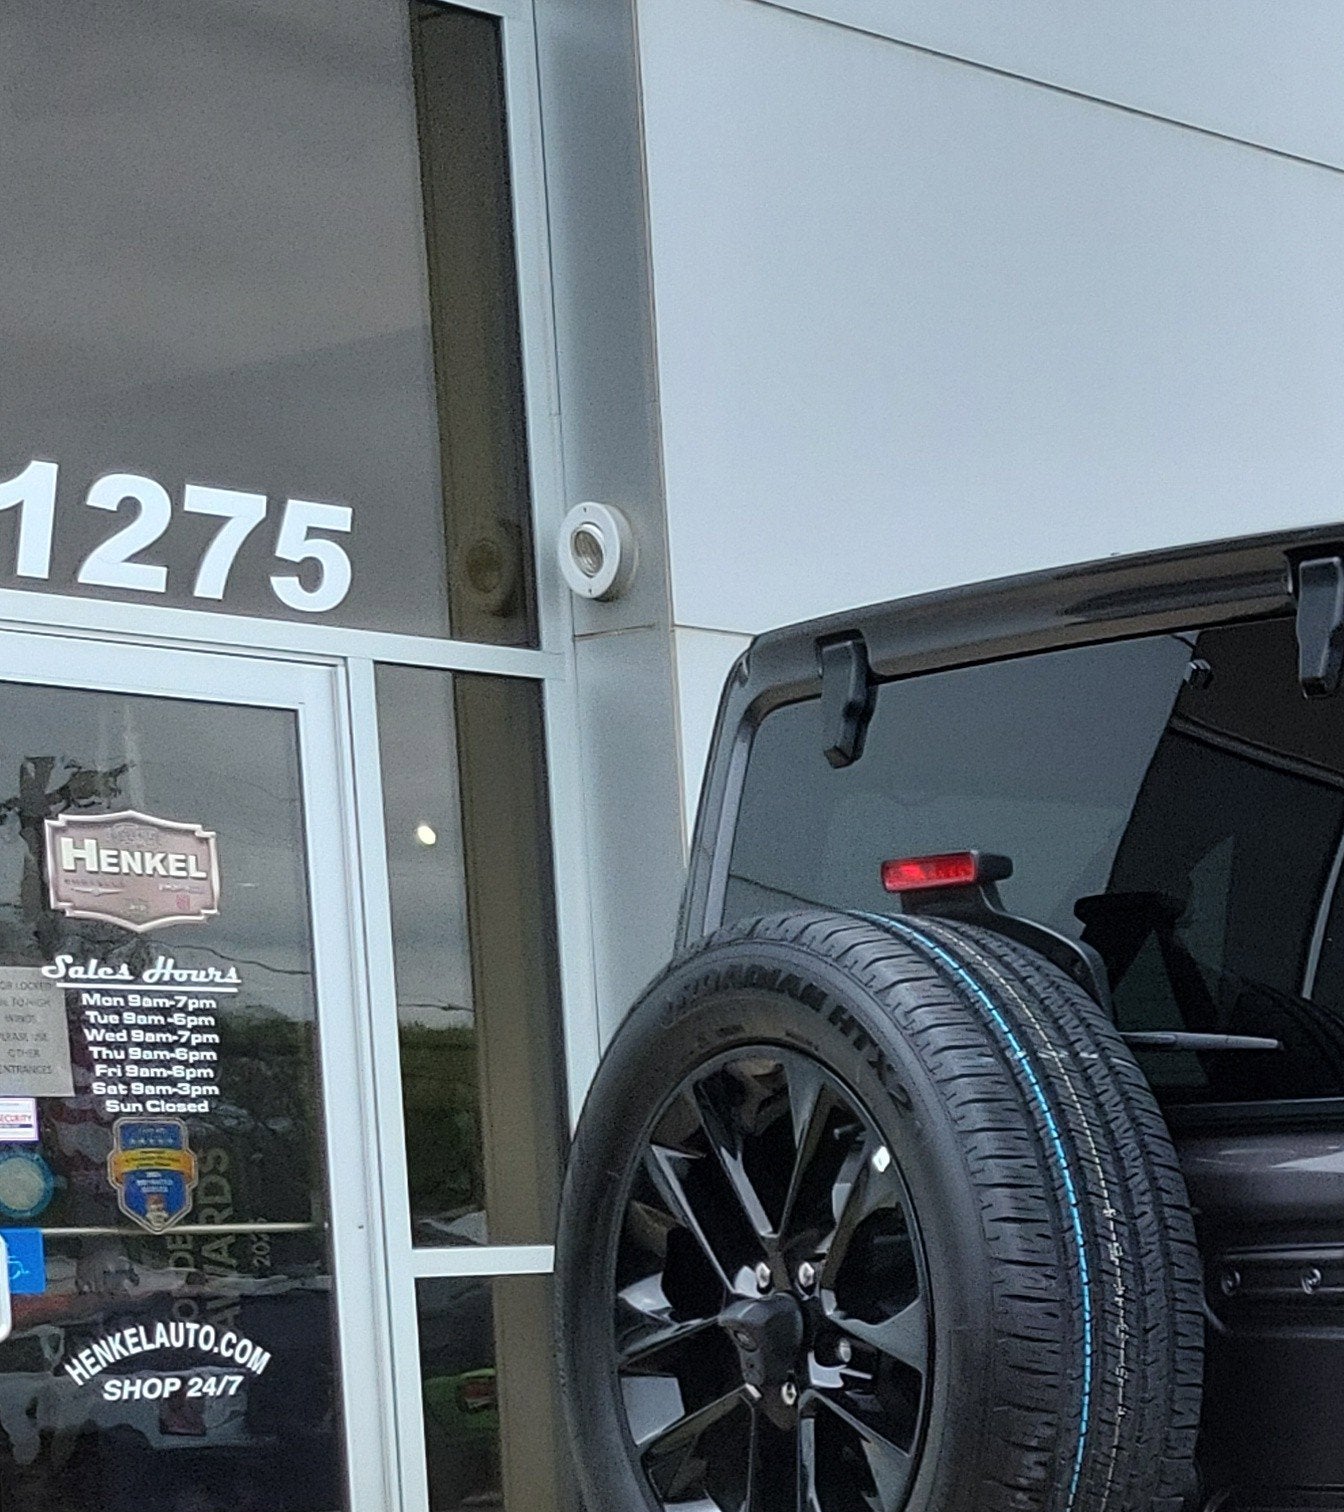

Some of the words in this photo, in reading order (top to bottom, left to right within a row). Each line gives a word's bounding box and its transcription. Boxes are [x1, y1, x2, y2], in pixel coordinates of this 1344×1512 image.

[0, 459, 353, 612] 1275
[60, 836, 208, 879] HENKEL
[41, 954, 134, 980] Sales
[142, 955, 242, 983] Hours
[81, 993, 125, 1008] Mon
[128, 994, 217, 1011] 9am-7pm
[85, 1010, 120, 1025] Tue
[83, 1028, 128, 1042] Wed
[131, 1029, 220, 1046] 9am-7pm
[88, 1046, 125, 1060] Thu
[129, 1047, 218, 1064] 9am-6pm
[95, 1063, 122, 1077] Fri
[125, 1065, 214, 1081] 9am-6pm
[91, 1081, 128, 1096] Sat
[130, 1082, 220, 1099] 9am-3pm
[105, 1099, 143, 1113] Sun
[146, 1099, 210, 1113] Closed
[63, 1321, 272, 1386] HENKELAUTO.COM
[103, 1377, 181, 1401] SHOP
[186, 1374, 245, 1399] 24/7
